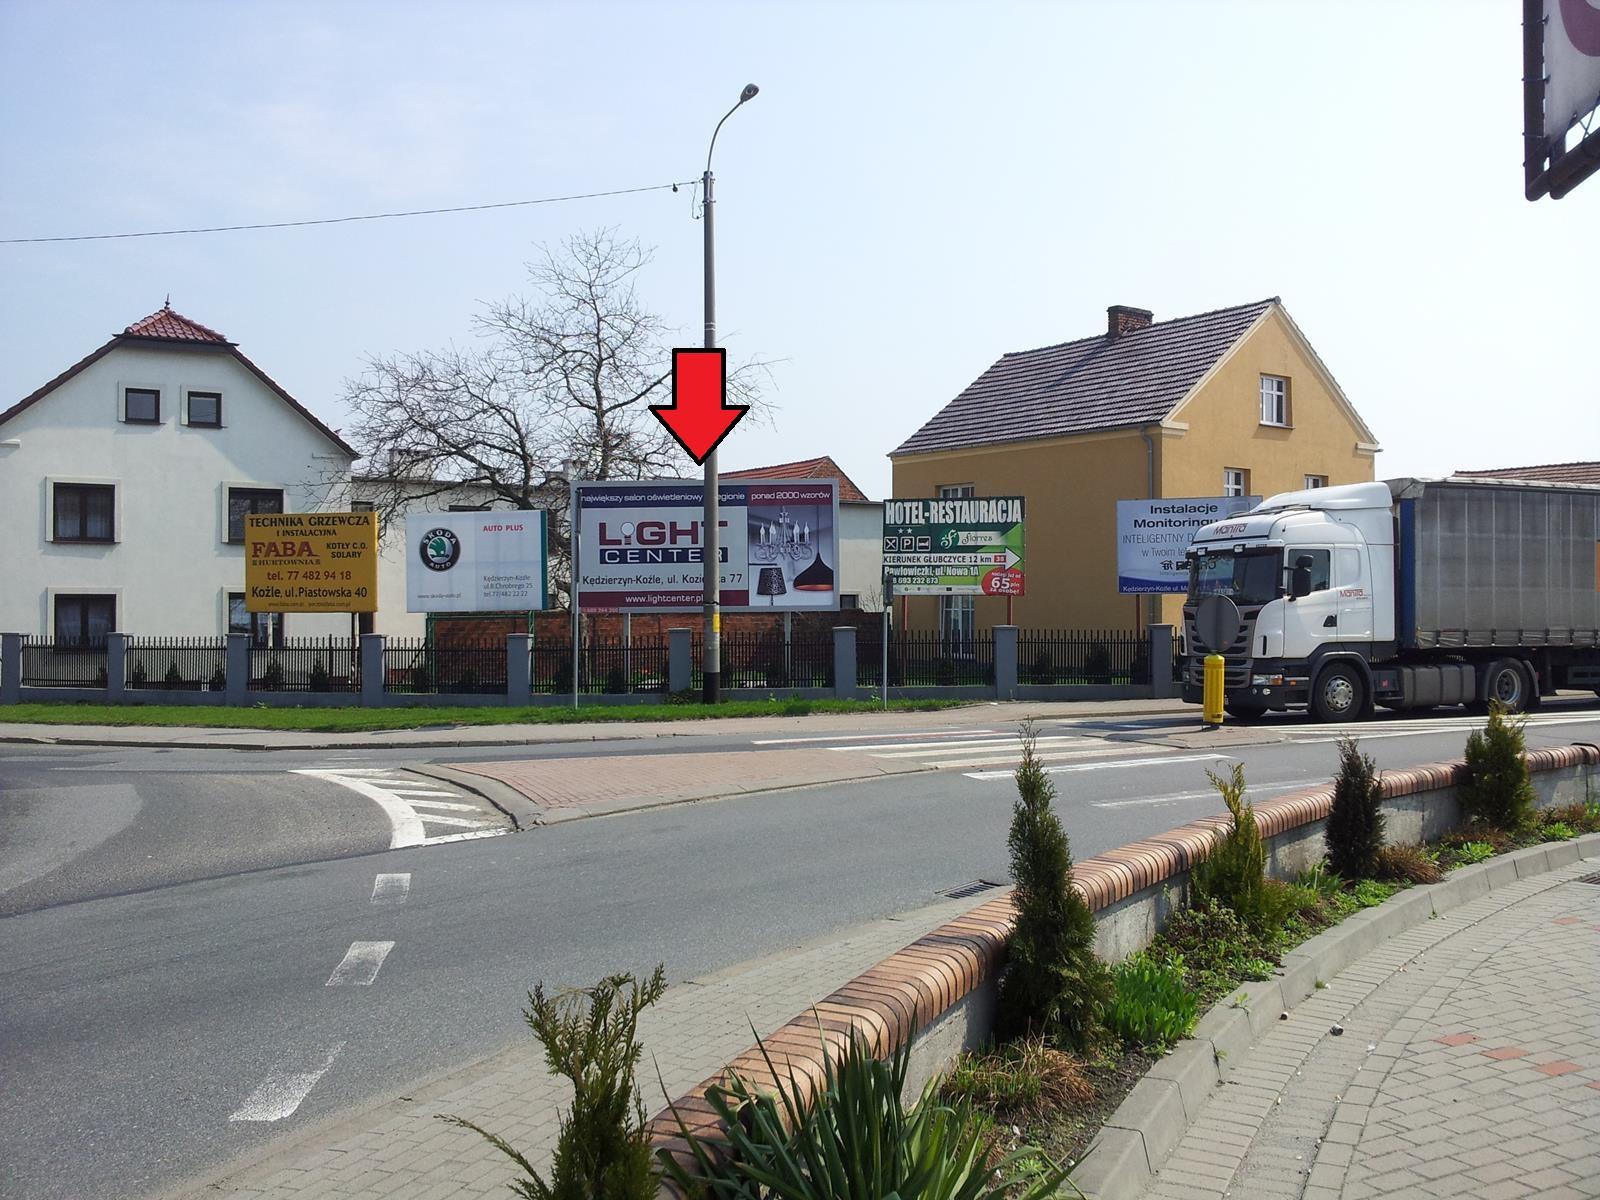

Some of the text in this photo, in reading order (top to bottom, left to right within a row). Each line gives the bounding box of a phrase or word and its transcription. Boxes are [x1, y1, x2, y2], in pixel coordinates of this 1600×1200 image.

[751, 491, 831, 501] ponad 2000 wzorów
[885, 499, 1023, 525] HOTEL-RESTAURACJA
[1150, 503, 1218, 515] Instalacje
[249, 515, 370, 528] TECHNIKA GRZEWCZA
[282, 528, 337, 537] INSTALACYJNA
[483, 524, 524, 532] AUTO PLUS
[1122, 532, 1185, 544] INTELIGENTNY
[251, 541, 321, 558] FABA
[326, 542, 351, 550] KOTŁY
[330, 551, 362, 559] SOLARY
[1141, 549, 1149, 557] w
[1151, 547, 1176, 557] Twoim
[884, 555, 922, 564] KIERUNEK
[923, 554, 967, 563] GŁUBCZYCE
[968, 555, 978, 563] 12
[980, 554, 992, 563] km
[429, 561, 452, 569] AUTO
[267, 570, 352, 581] tel. 77 482 94 18
[884, 566, 934, 577] Pawłowiczki,
[946, 566, 969, 576] Nowa
[970, 566, 979, 576] 1A
[667, 574, 679, 584] ul.
[729, 573, 743, 583] 77
[912, 576, 926, 584] 232
[991, 577, 1010, 589] 65
[354, 586, 368, 597] 40
[625, 594, 704, 604] www.lightcenter.pl
